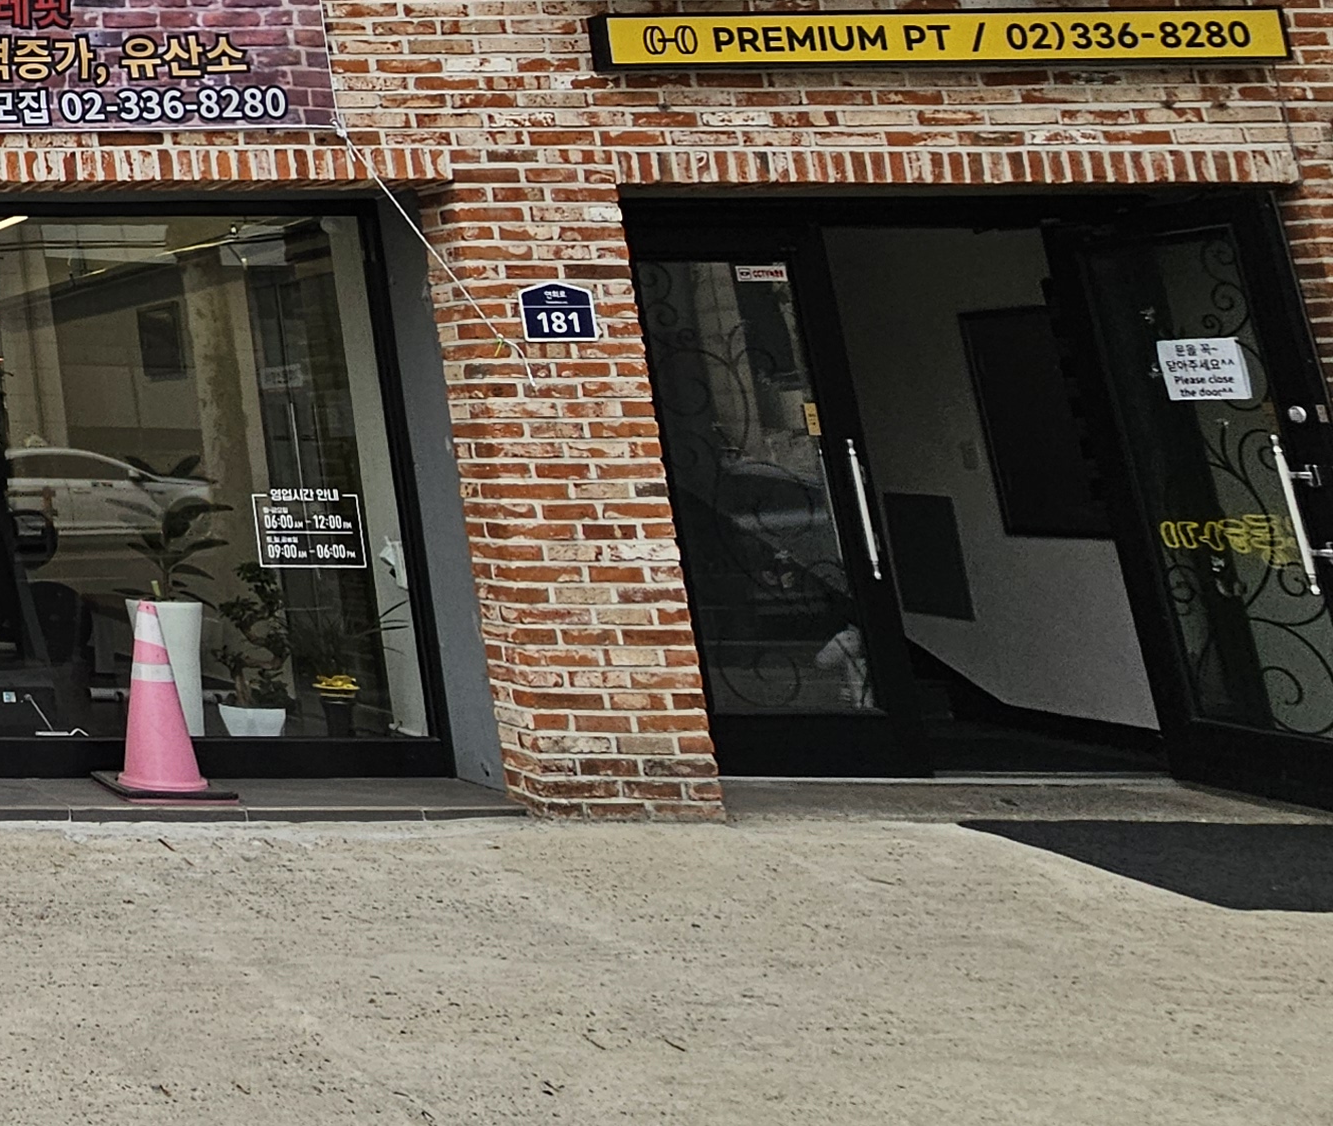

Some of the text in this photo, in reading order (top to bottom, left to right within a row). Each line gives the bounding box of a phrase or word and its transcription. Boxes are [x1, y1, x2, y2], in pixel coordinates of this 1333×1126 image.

[712, 22, 889, 54] PREMIUM
[903, 21, 951, 52] PT
[1005, 18, 1252, 52] 02)336-8280
[119, 34, 249, 79] 유산소
[58, 84, 288, 124] 02-336-8280
[536, 311, 581, 333] 181
[1174, 375, 1235, 385] Please close
[270, 489, 339, 501] 영업시간 안내
[264, 515, 293, 529] 06:00
[313, 515, 342, 529] 12:00
[268, 544, 297, 558] 09:00
[316, 544, 346, 558] 06:00
